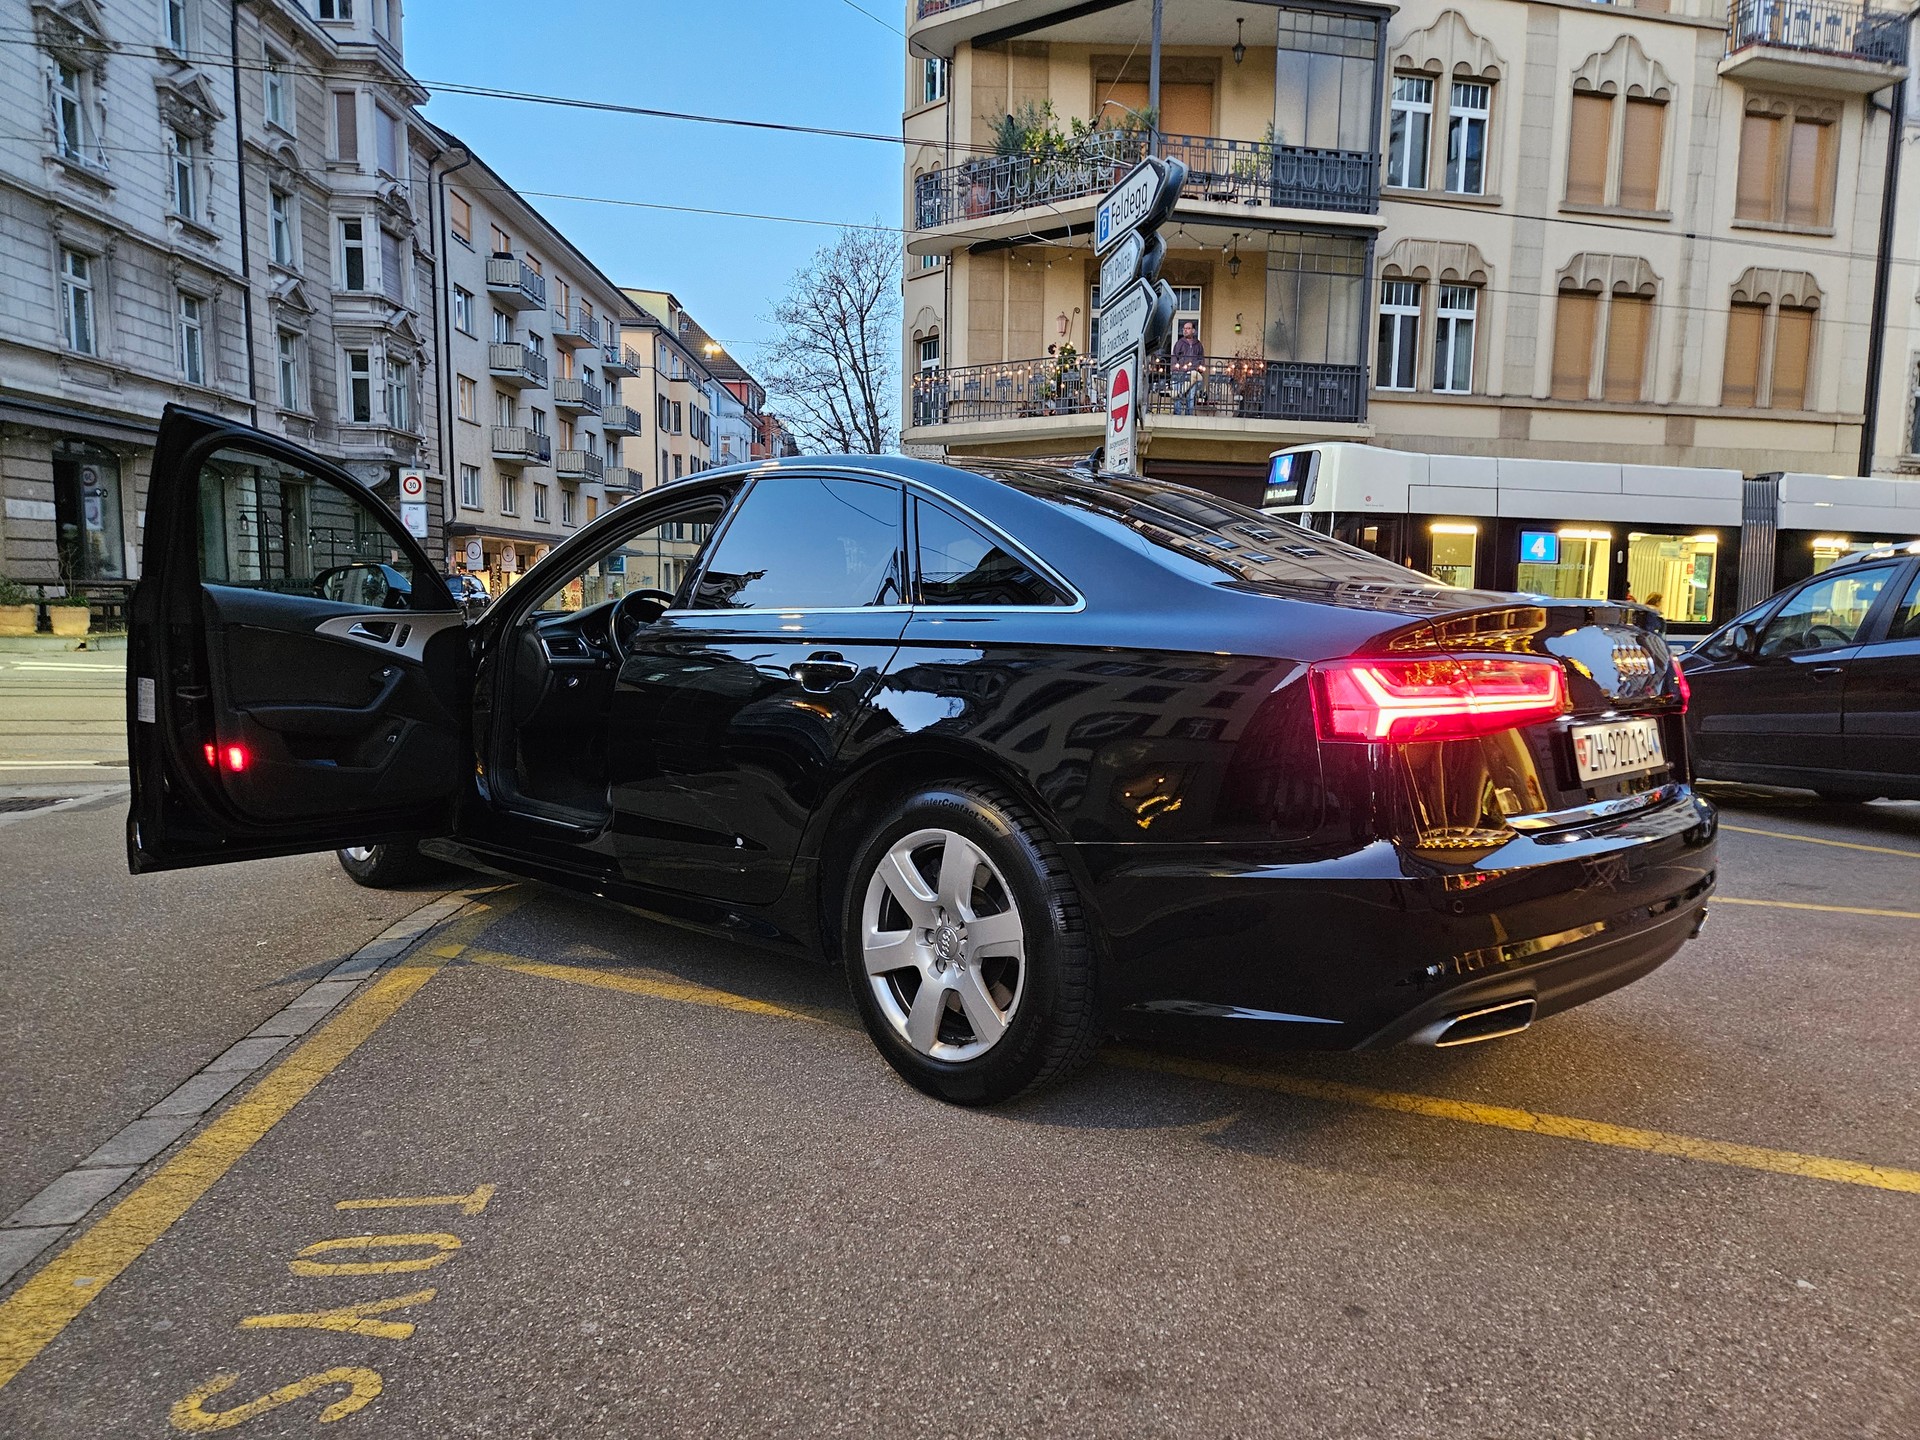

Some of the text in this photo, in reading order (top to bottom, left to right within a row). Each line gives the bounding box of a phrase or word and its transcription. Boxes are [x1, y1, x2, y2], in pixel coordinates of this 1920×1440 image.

[1111, 181, 1148, 230] Feldegg
[409, 481, 417, 489] 30
[1531, 537, 1546, 557] 4
